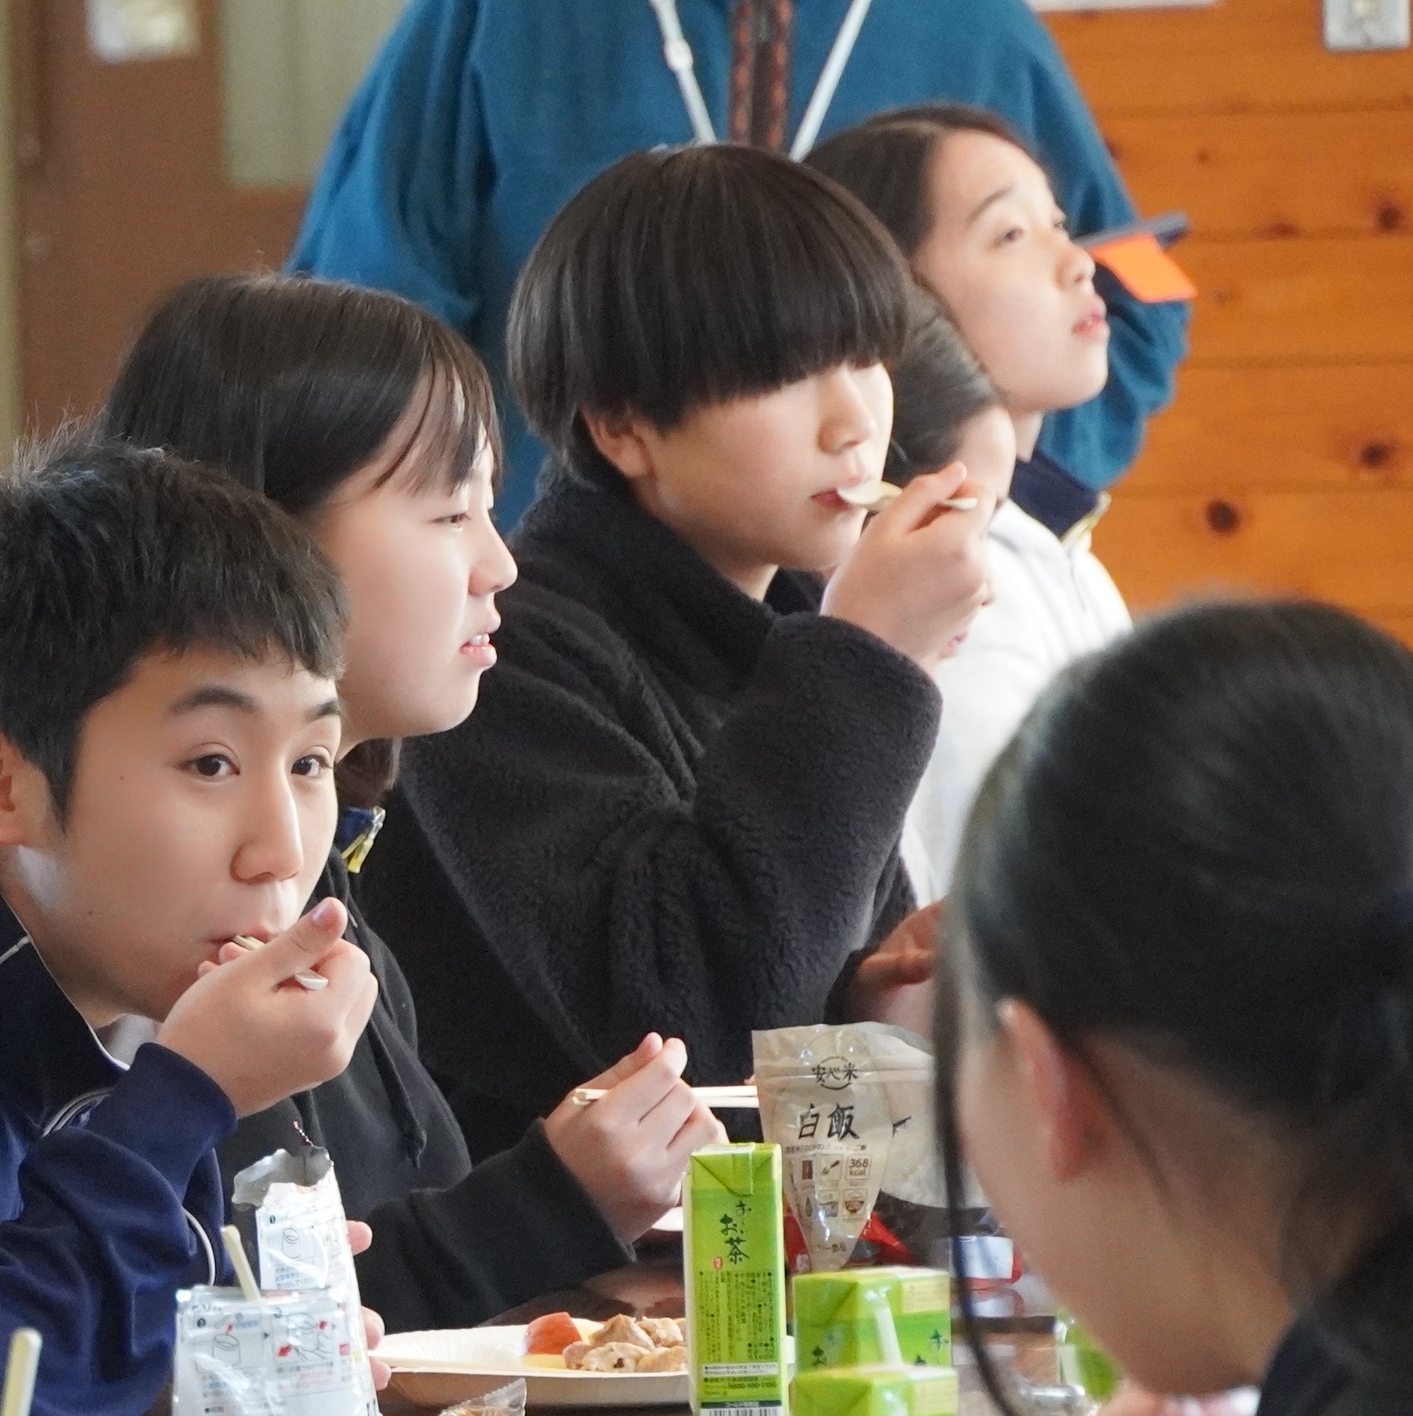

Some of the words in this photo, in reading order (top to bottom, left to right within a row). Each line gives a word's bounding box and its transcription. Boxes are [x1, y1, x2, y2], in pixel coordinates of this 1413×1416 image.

[812, 1062, 859, 1083] 安心米
[798, 1103, 860, 1140] 白飯
[849, 1159, 869, 1168] 368
